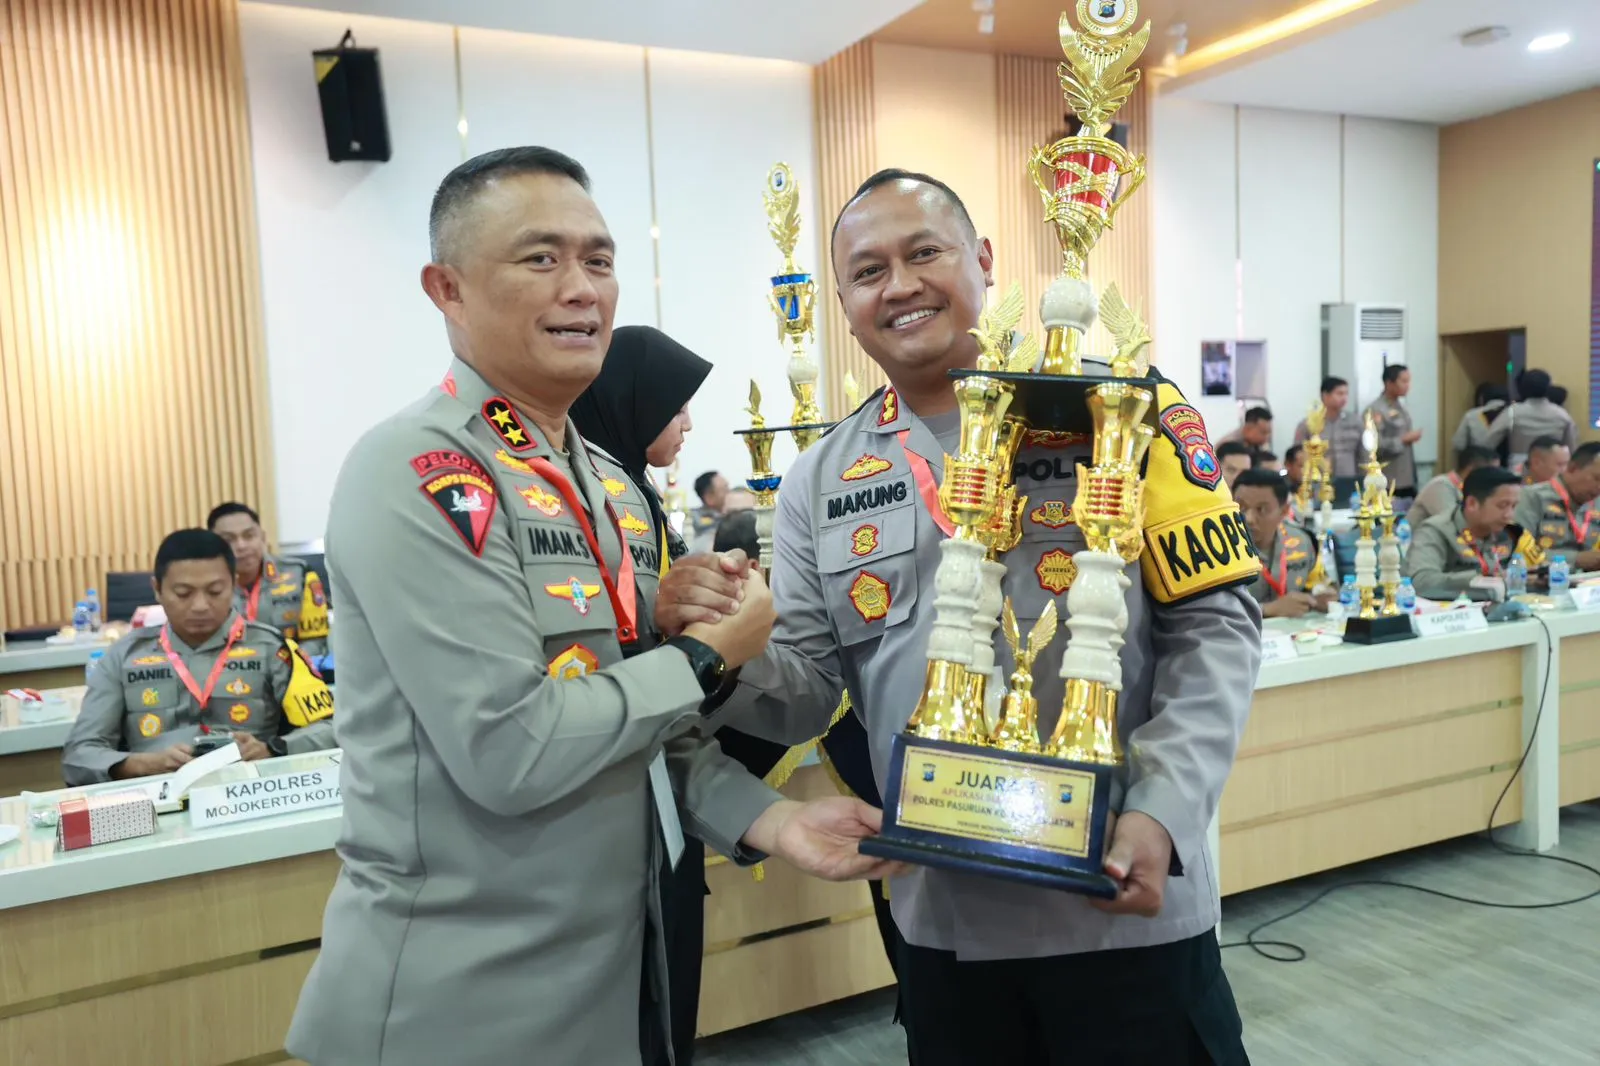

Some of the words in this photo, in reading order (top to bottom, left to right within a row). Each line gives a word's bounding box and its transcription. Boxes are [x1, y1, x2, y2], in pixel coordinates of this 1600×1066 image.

[1014, 455, 1092, 481] POL
[828, 481, 907, 520] MAKUNG
[528, 527, 591, 560] IMAM.S
[127, 668, 173, 683] DANIEL
[223, 661, 261, 671] OLRI
[226, 772, 322, 799] KAPOLRES
[206, 794, 301, 818] MOJOKERTO
[305, 787, 340, 802] KOTA
[913, 795, 945, 808] POLRES
[947, 800, 992, 816] PASURUAN
